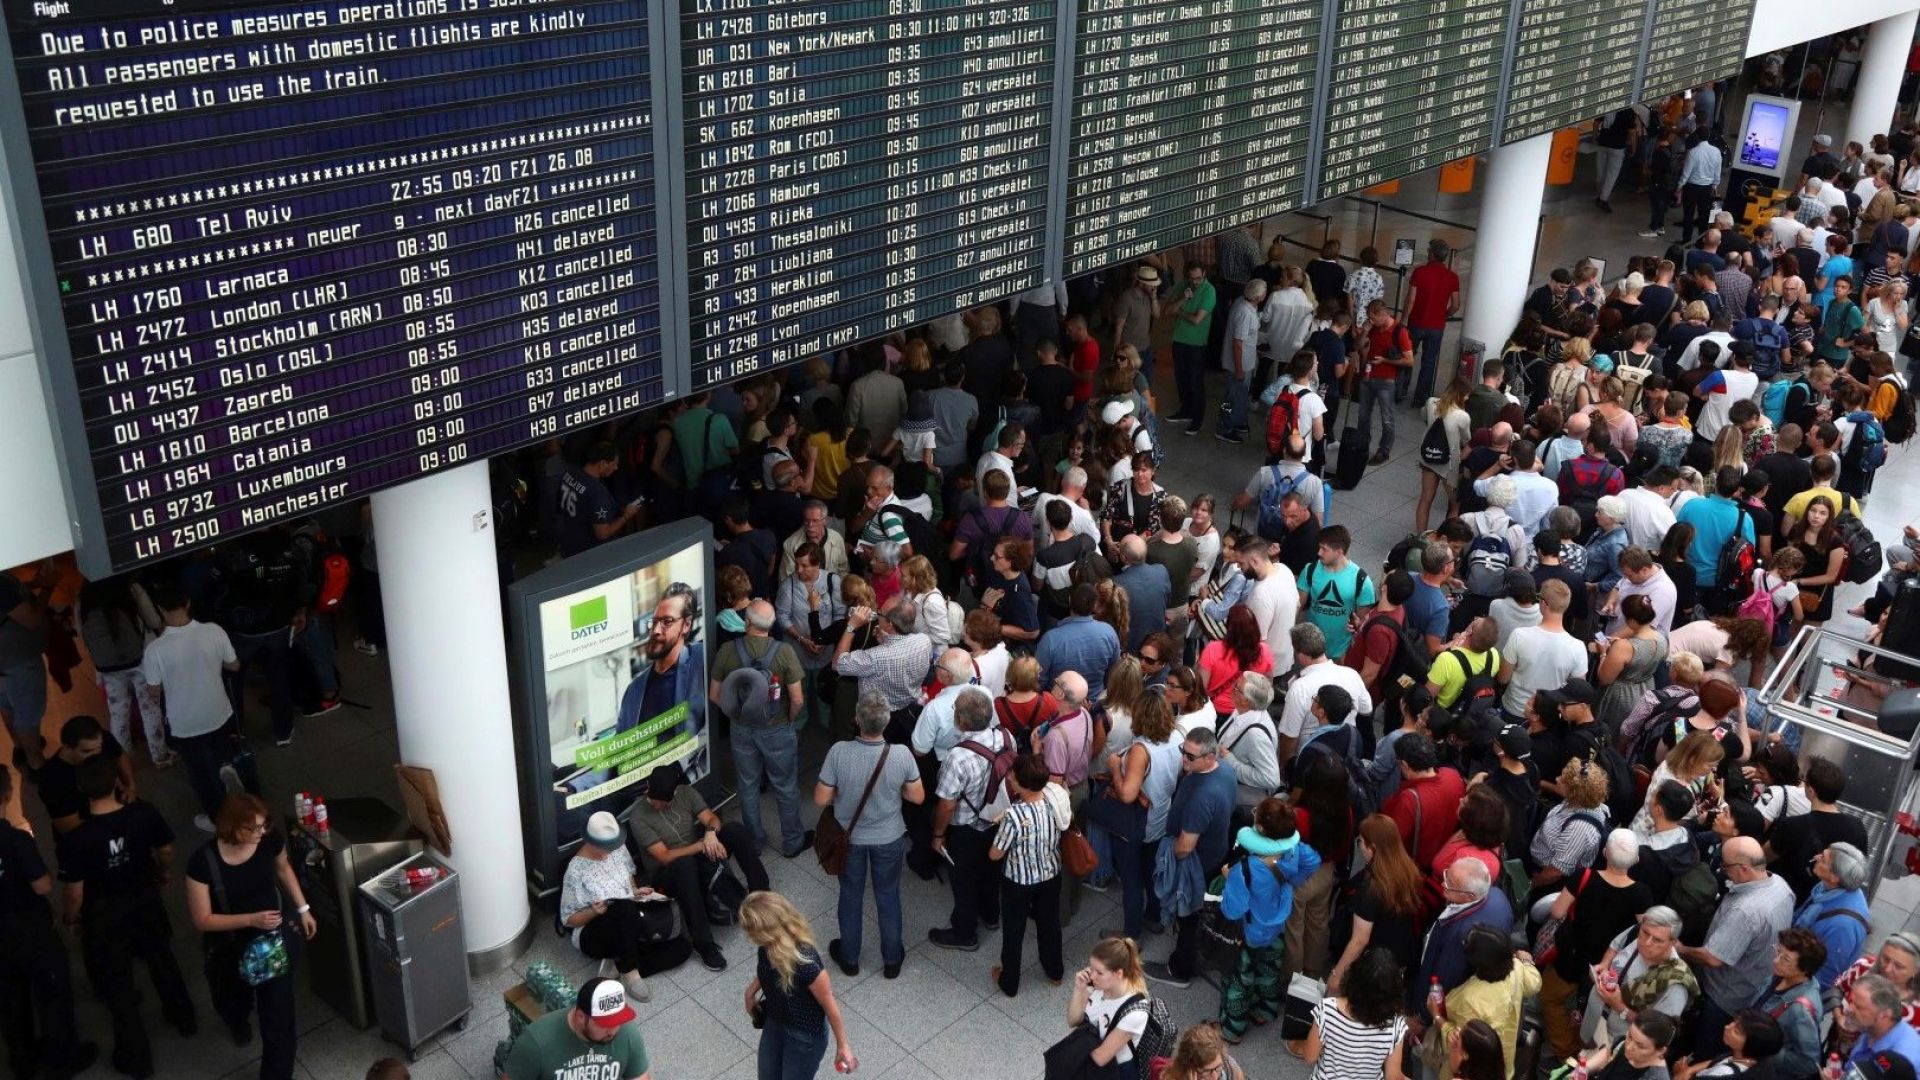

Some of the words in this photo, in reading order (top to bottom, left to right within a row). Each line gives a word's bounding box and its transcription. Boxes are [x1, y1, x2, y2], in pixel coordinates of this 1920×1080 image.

[34, 1, 70, 17] Flight
[41, 32, 85, 55] Due
[101, 27, 127, 48] to
[140, 19, 219, 44] police
[231, 10, 327, 35] measures
[338, 0, 447, 23] operations
[698, 48, 713, 66] UA
[729, 43, 752, 62] 031
[768, 39, 790, 57] New
[889, 20, 921, 40] 09:30
[928, 15, 959, 34] 11:00
[989, 6, 1029, 26] 320-326
[48, 65, 89, 90] All
[104, 53, 236, 84] passengers
[248, 42, 296, 66] with
[308, 32, 398, 59] domestic
[410, 22, 481, 47] flights
[491, 20, 520, 38] are
[529, 10, 585, 33] kindly
[698, 74, 714, 93] EN
[722, 68, 753, 89] 8218
[768, 62, 797, 82] Bari
[888, 43, 920, 64] 09:35
[55, 89, 177, 125] requested
[192, 87, 215, 107] to
[227, 83, 264, 102] use
[278, 75, 311, 96] the
[325, 66, 387, 89] train.
[79, 235, 108, 260] LH
[132, 224, 172, 250] 680
[196, 213, 231, 237] Tel
[245, 204, 292, 229] Aviv
[391, 174, 442, 201] 22:55
[452, 164, 501, 190] 09:20
[510, 158, 538, 179] F21
[548, 147, 593, 172] 26.08
[307, 223, 361, 248] neuer
[435, 198, 473, 222] next
[702, 200, 718, 218] LH
[725, 192, 755, 214] 2066
[770, 182, 820, 204] Hamburg
[888, 158, 918, 179] 10:15
[703, 224, 718, 243] OU
[726, 216, 756, 237] 4435
[770, 205, 813, 227] Rijeka
[887, 180, 918, 201] 10:15
[924, 172, 954, 193] 11:00
[983, 157, 1028, 179] Check-in
[91, 299, 119, 323] LH
[133, 286, 182, 314] 1760
[205, 268, 289, 299] Larnaca
[397, 231, 448, 258] 08:30
[514, 211, 543, 234] H26
[551, 193, 630, 226] cancelled
[703, 249, 719, 267] A3
[733, 240, 755, 260] 501
[770, 217, 852, 250] Thessaloniki
[887, 202, 917, 223] 10:20
[958, 188, 977, 206] K16
[97, 330, 124, 354] LH
[136, 317, 187, 346] 2472
[210, 300, 281, 329] London
[400, 259, 450, 286] 08:45
[516, 238, 543, 261] H41
[553, 223, 615, 252] delayed
[103, 361, 129, 385] LH
[141, 346, 192, 376] 2414
[215, 320, 318, 358] Stockholm
[403, 286, 452, 314] 08:50
[518, 264, 546, 287] K12
[555, 244, 632, 278] cancelled
[108, 391, 134, 415] LH
[146, 376, 196, 405] 2452
[219, 363, 266, 387] Oslo
[405, 313, 455, 341] 08:55
[520, 290, 548, 313] K03
[556, 269, 634, 303] cancelled
[114, 421, 139, 444] OU
[151, 405, 199, 433] 4437
[224, 383, 293, 416] Zagreb
[408, 339, 457, 368] 08:55
[522, 316, 550, 339] H35
[558, 298, 618, 329] delayed
[707, 365, 722, 384] LH
[730, 355, 758, 377] 1856
[772, 336, 820, 364] Mailand
[885, 308, 915, 330] 10:40
[119, 450, 144, 474] LH
[159, 434, 205, 463] 1810
[228, 405, 329, 445] Barcelona
[411, 366, 460, 395] 09:00
[524, 341, 551, 364] K18
[560, 318, 636, 354] cancelled
[125, 479, 149, 503] LH
[164, 462, 209, 492] 1964
[233, 438, 311, 472] Catania
[414, 392, 462, 421] 09:00
[562, 343, 637, 378] cancelled
[135, 536, 159, 559] LH
[172, 518, 218, 548] 2500
[241, 482, 348, 526] Manchester
[420, 443, 467, 472] 09:00
[530, 415, 557, 438] H38
[565, 391, 639, 427] cancelled
[167, 490, 214, 520] 9732
[237, 456, 346, 500] Luxembourg
[417, 417, 465, 446] 09:00
[563, 371, 622, 403] delayed
[561, 484, 577, 517] 76
[571, 621, 607, 640] DATEV
[581, 746, 605, 761] Voll
[609, 706, 685, 750] durchstarten?
[554, 1064, 600, 1080] TIMBER
[601, 1061, 620, 1080] CO
[568, 1054, 585, 1067] LAKE
[587, 1054, 608, 1063] TAHOE
